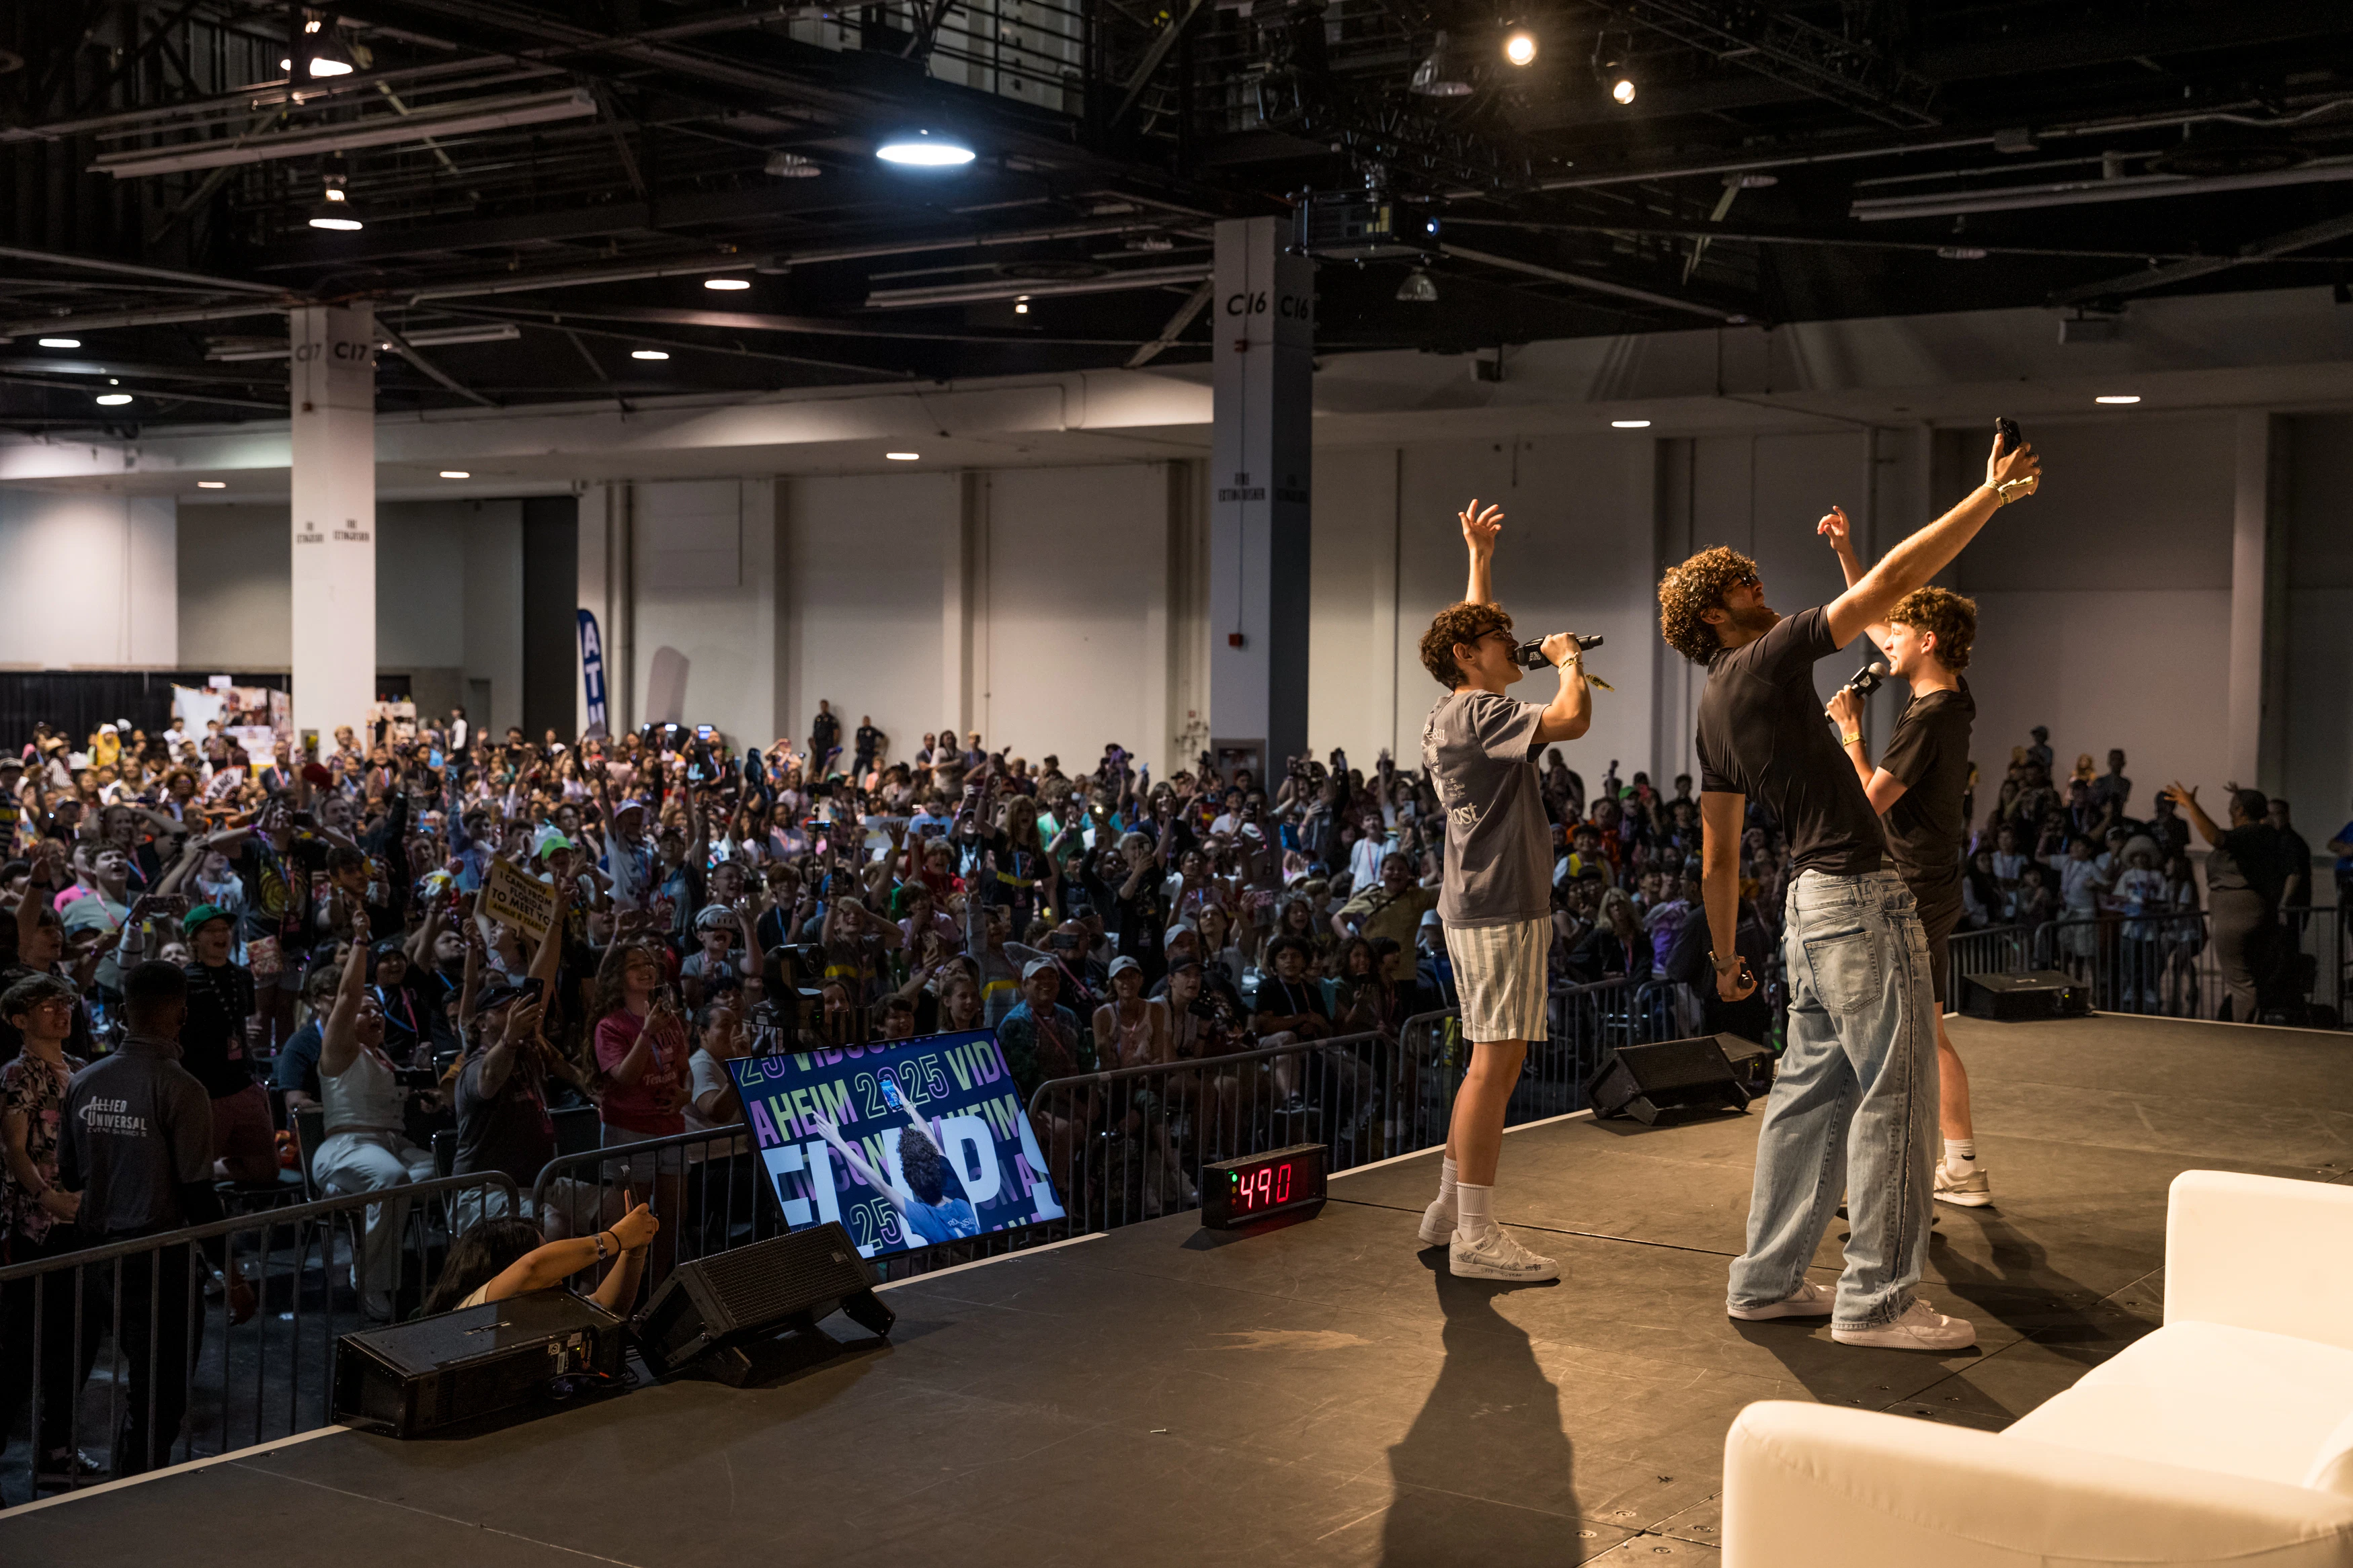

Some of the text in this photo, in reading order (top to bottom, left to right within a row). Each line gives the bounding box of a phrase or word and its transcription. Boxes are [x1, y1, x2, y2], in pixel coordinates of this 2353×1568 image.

[1228, 291, 1265, 315] C16
[1281, 296, 1308, 319] C16
[335, 341, 367, 361] C17
[1433, 728, 1445, 741] 8:11
[506, 874, 526, 892] CAME
[528, 889, 552, 907] FROM
[510, 887, 543, 911] FLORIDA
[493, 888, 551, 925] TO MEET YO
[89, 1096, 127, 1112] ALLIED
[87, 1111, 147, 1130] UNIVERSAL
